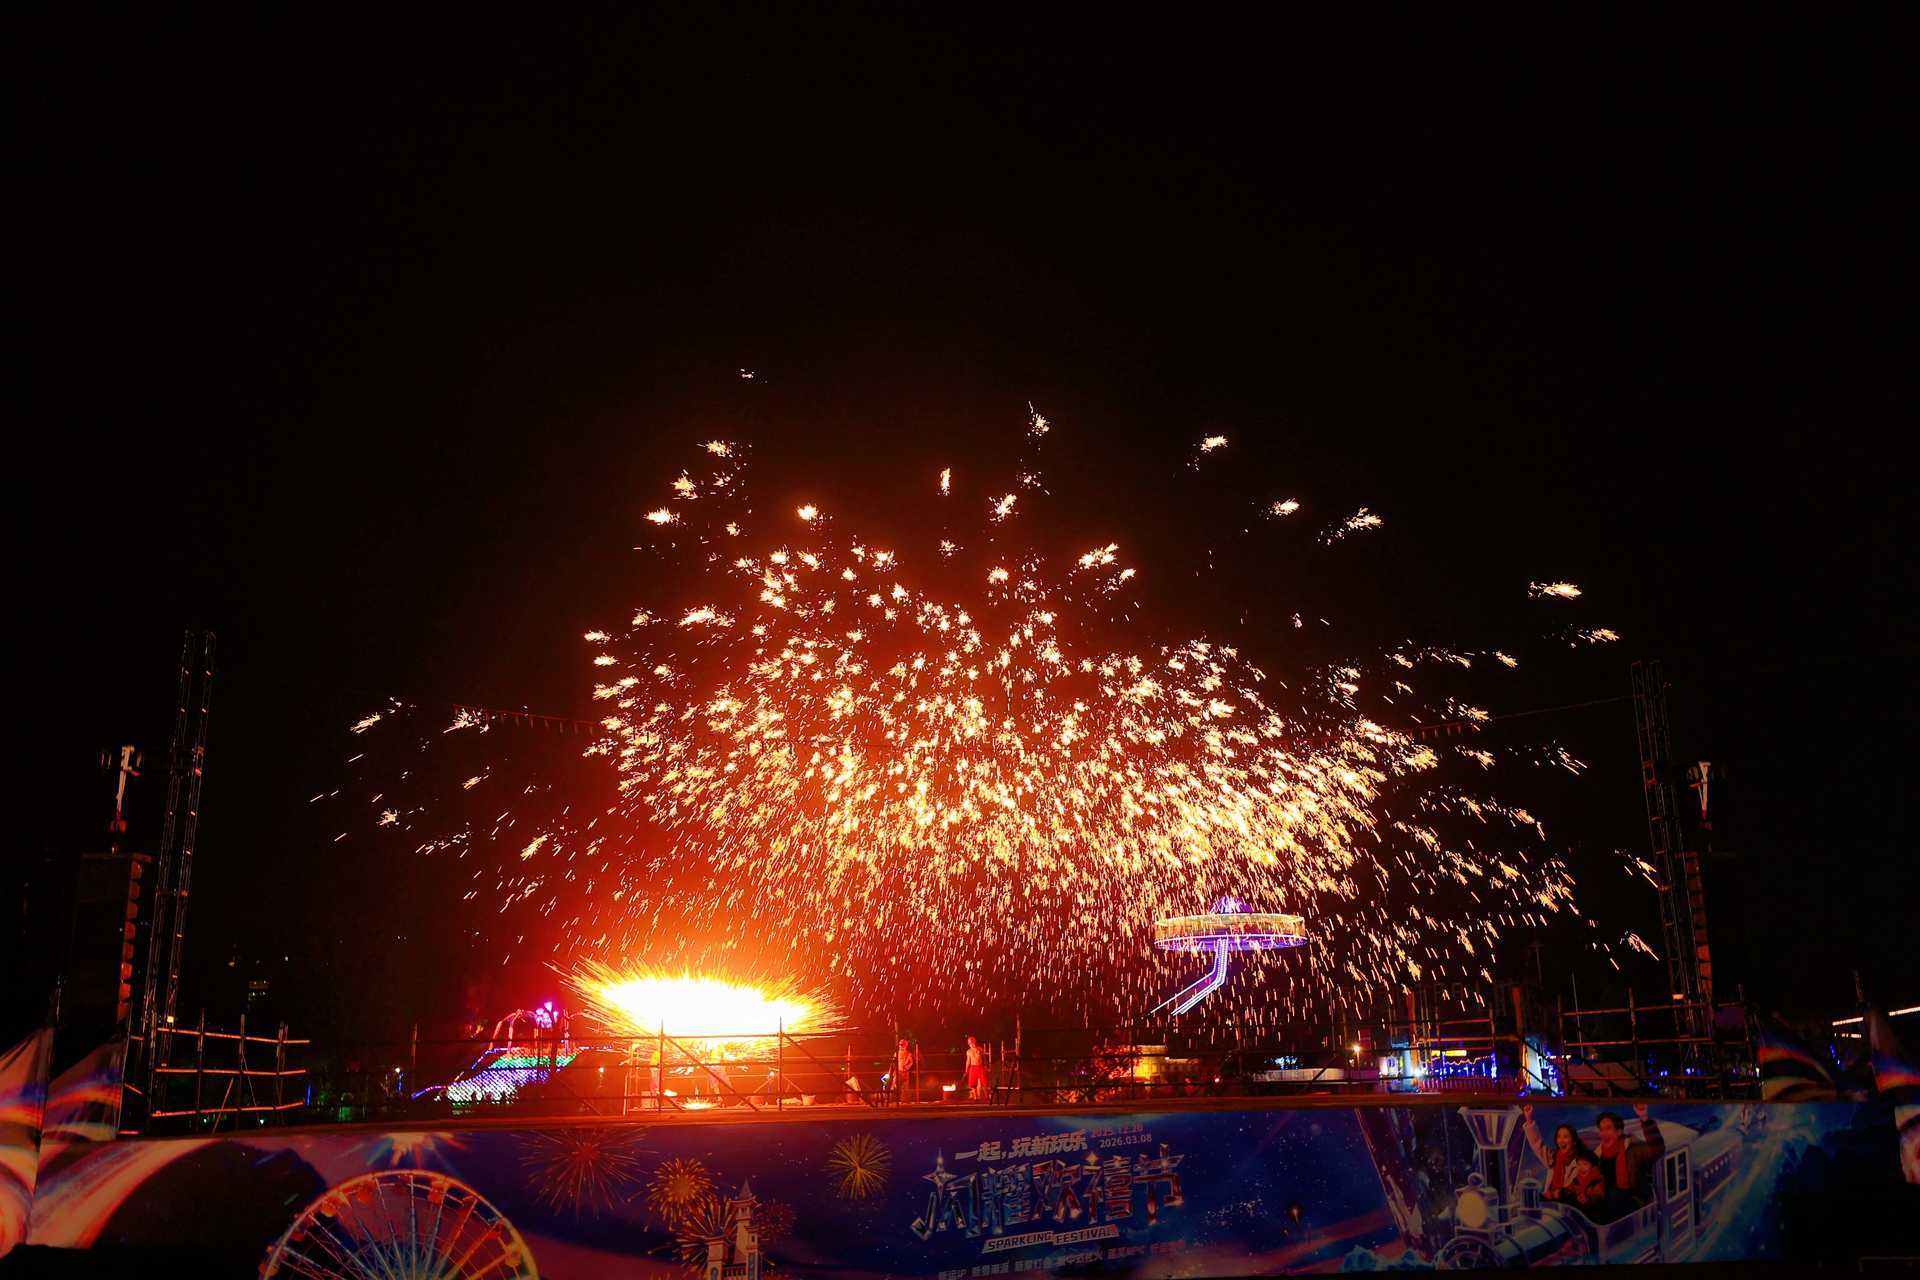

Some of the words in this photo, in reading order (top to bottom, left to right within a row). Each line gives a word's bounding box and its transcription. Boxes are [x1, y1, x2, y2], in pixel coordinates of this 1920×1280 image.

[1099, 1134, 1153, 1149] 2026.03.08
[987, 1232, 1053, 1250] SPARKLING
[1055, 1226, 1115, 1244] FESTIVAL
